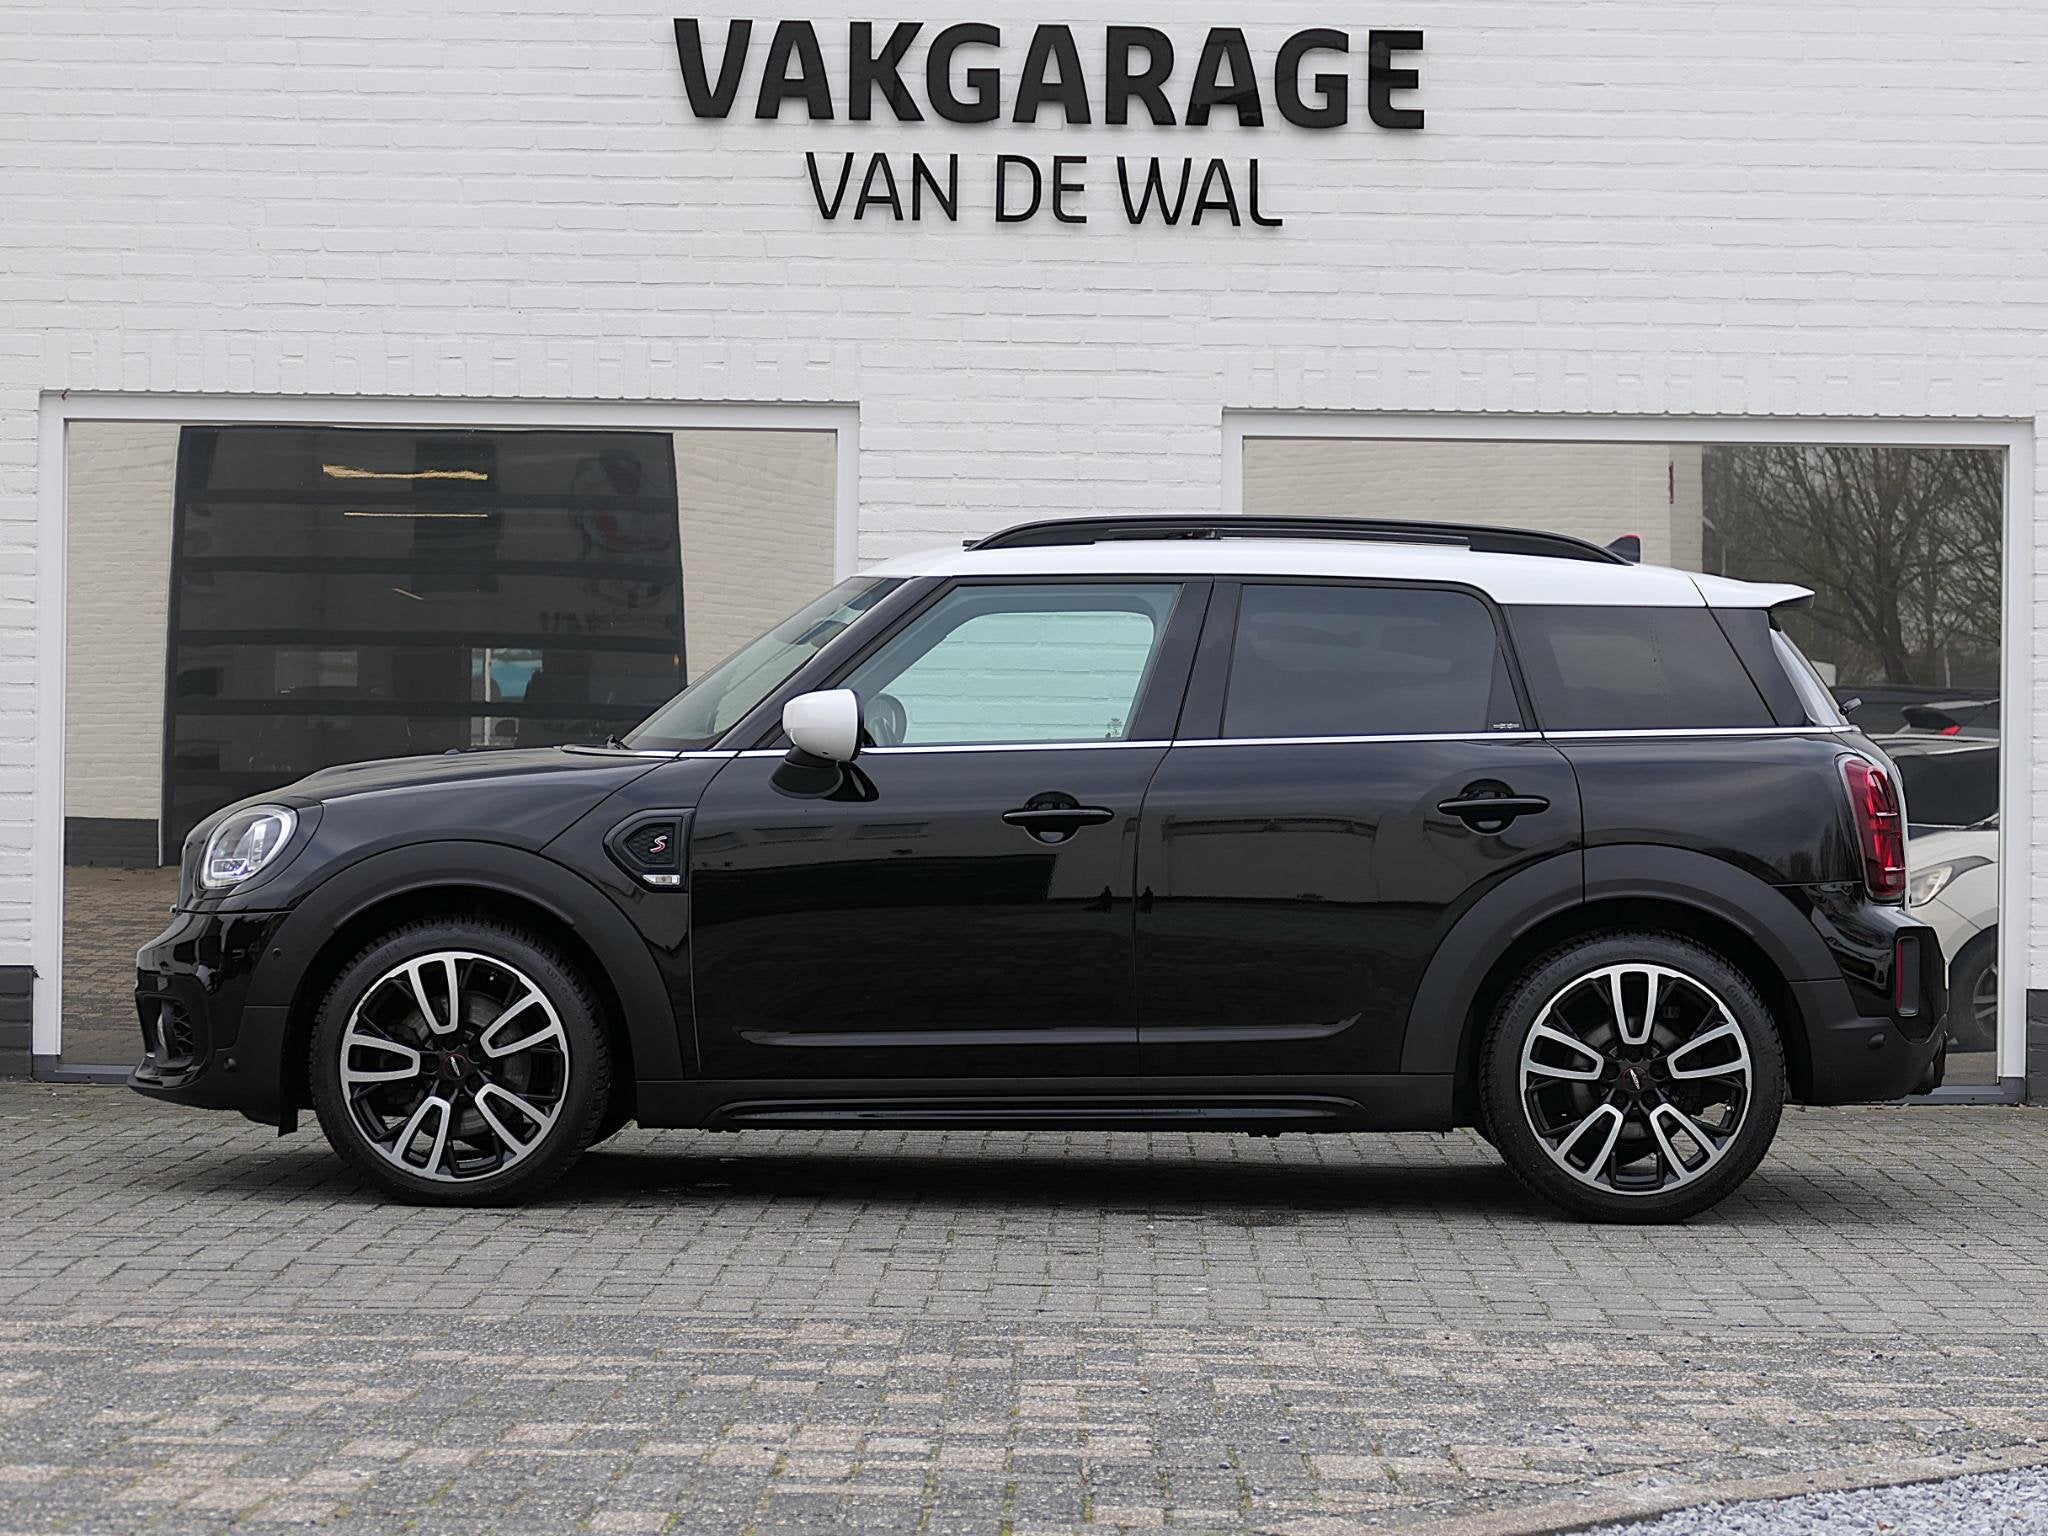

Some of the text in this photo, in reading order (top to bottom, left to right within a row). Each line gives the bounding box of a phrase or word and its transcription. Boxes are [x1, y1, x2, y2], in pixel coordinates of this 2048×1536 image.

[673, 18, 1425, 130] VAKGARAGE
[806, 152, 1283, 227] VAN DE WAL
[649, 835, 668, 854] S
